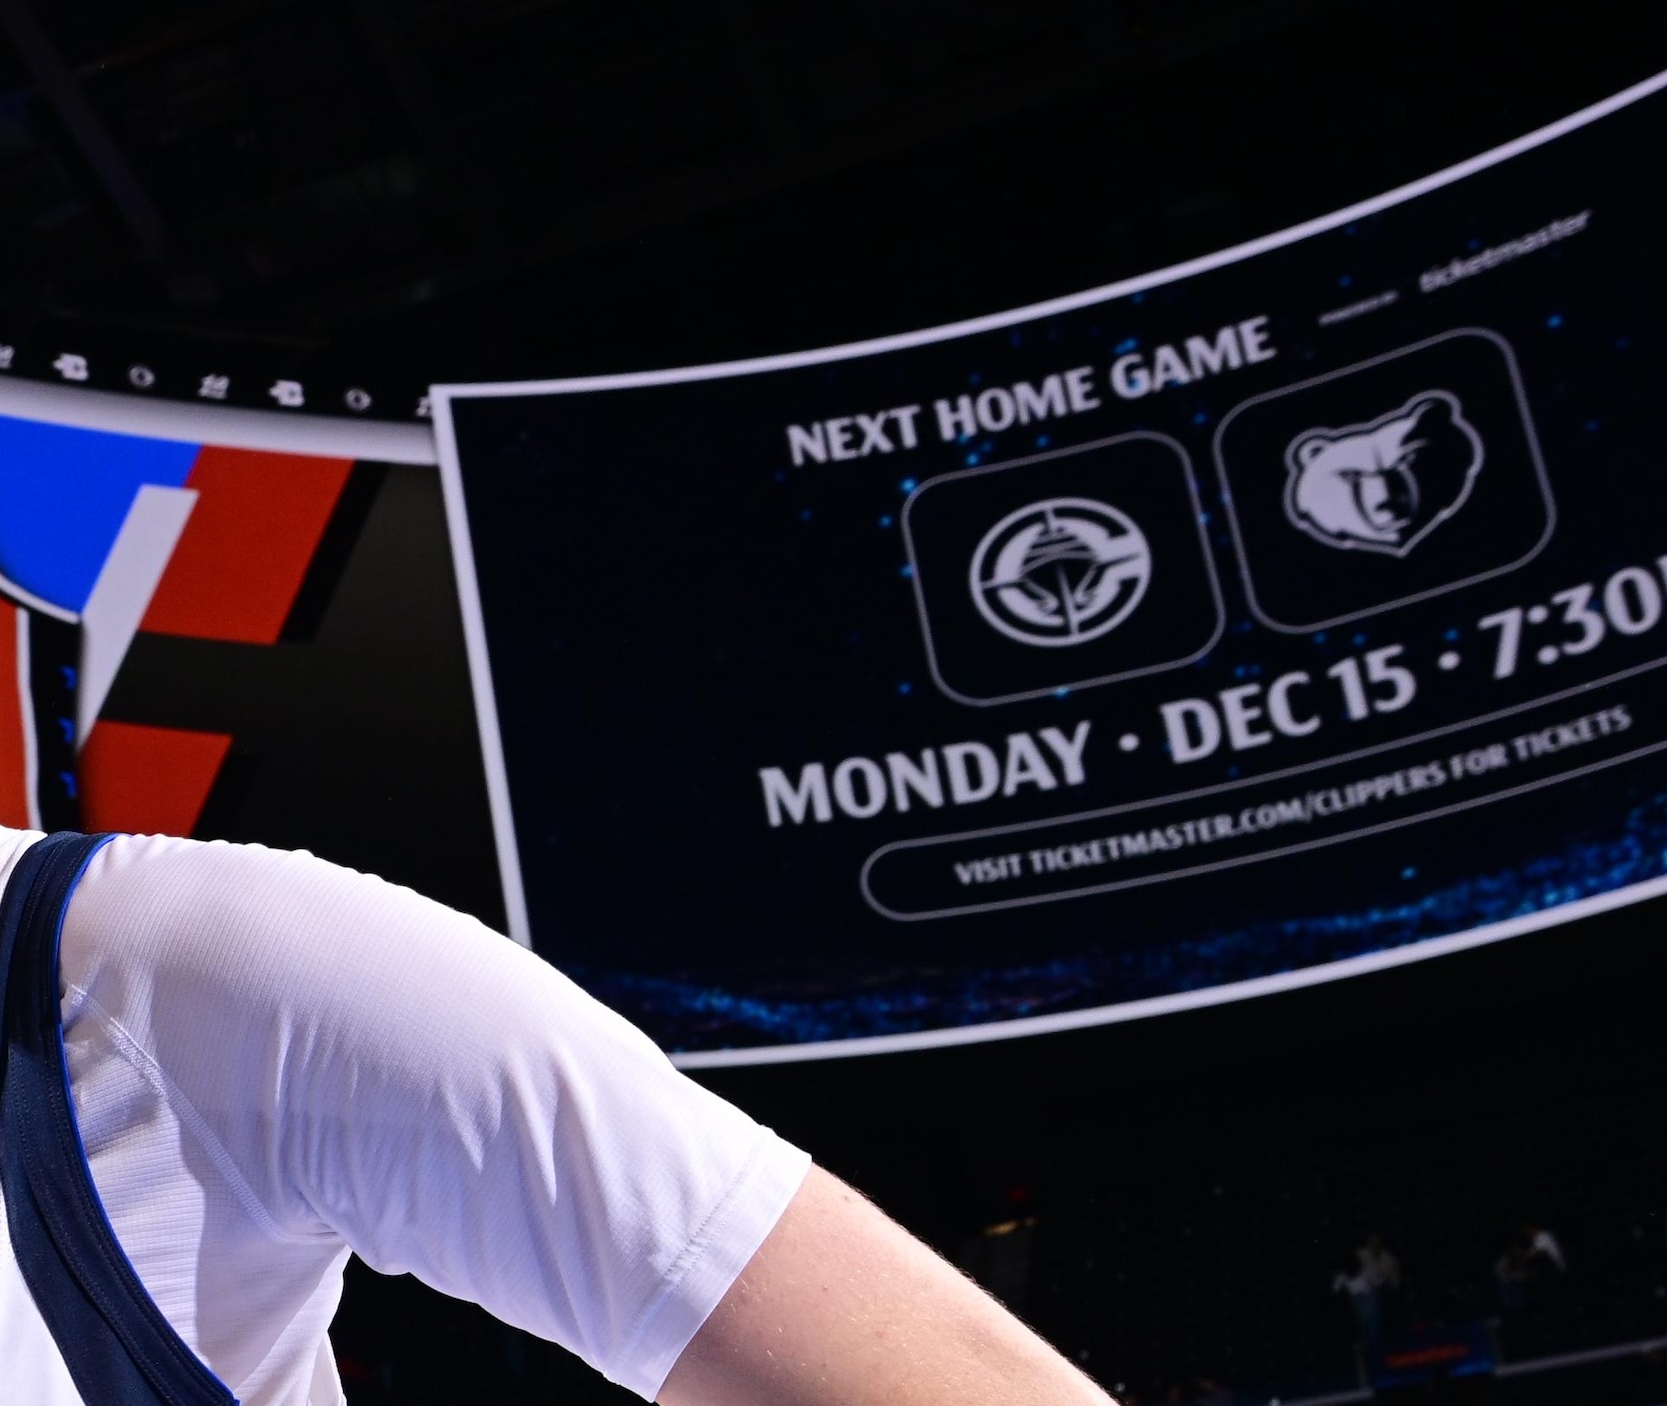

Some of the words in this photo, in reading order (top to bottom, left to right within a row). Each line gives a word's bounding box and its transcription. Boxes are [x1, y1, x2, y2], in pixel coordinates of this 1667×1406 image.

[787, 404, 922, 468] NEXT
[935, 365, 1101, 442] HOME
[1110, 315, 1277, 399] GAME
[758, 720, 1093, 828] MONDAY
[1160, 673, 1322, 765] DEC
[1326, 643, 1417, 722] 15
[1477, 554, 1667, 681] 7:30
[953, 853, 1022, 886] VISIT
[1028, 759, 1447, 873] TICKETMASTER.COM/CLIPPERS
[1449, 743, 1509, 780] FOR
[1511, 702, 1634, 762] TICKETS
